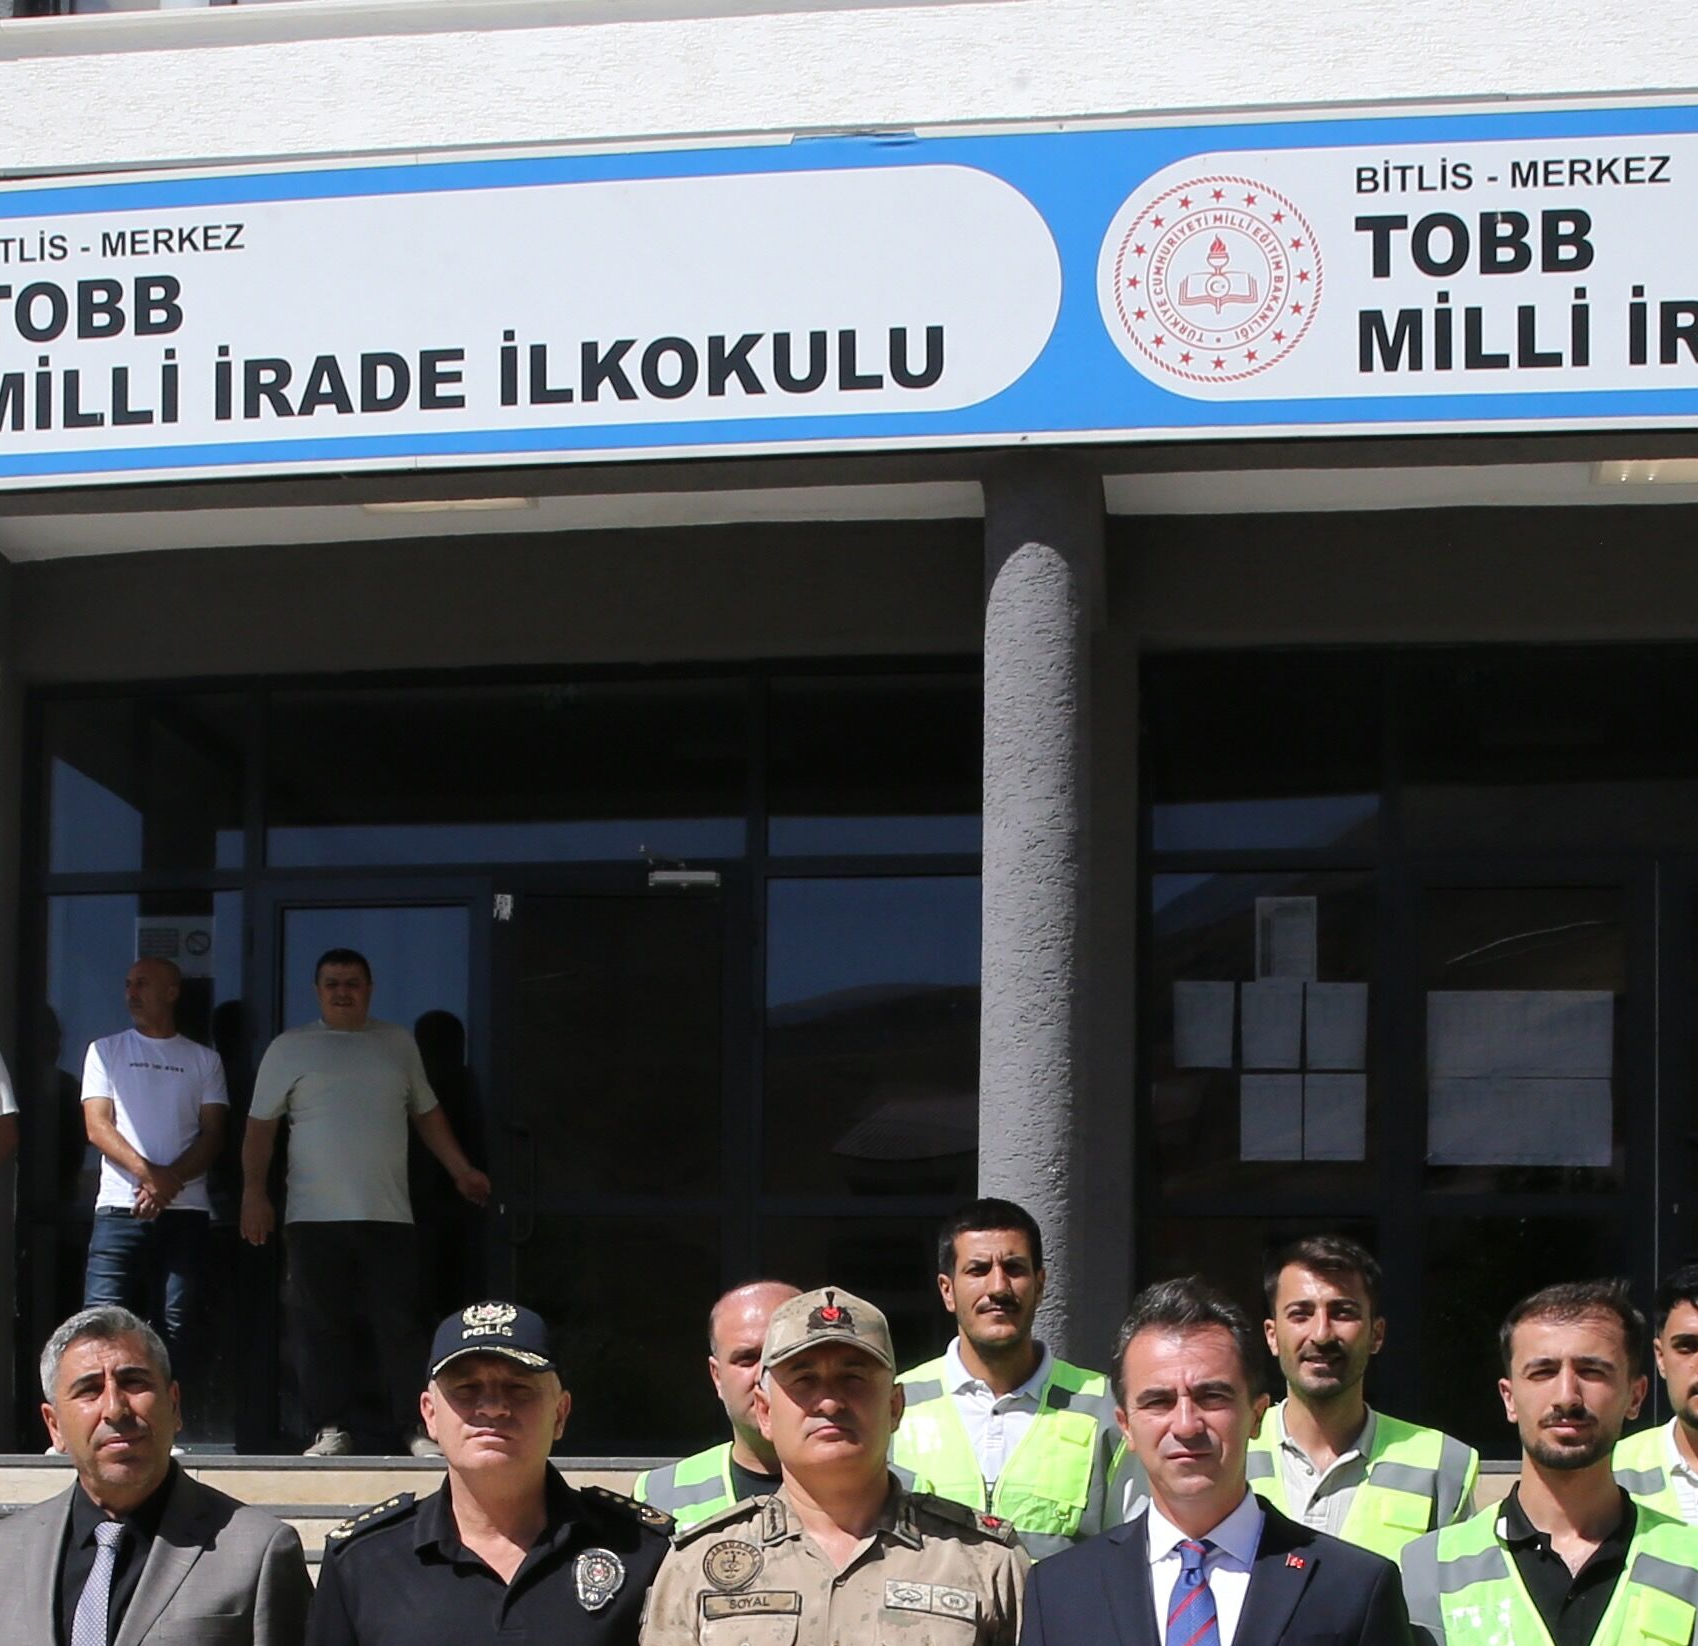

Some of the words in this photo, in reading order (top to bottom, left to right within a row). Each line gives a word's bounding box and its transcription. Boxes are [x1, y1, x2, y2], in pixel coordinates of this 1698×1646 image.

[1356, 158, 1473, 194] BİTLİS
[1511, 155, 1672, 188] MERKEZ
[102, 223, 245, 257] MERKEZ
[1213, 212, 1251, 231] MİLLİ
[1354, 208, 1595, 279] TOBB
[1153, 214, 1209, 295] CUMHURİYETİ
[1157, 299, 1204, 343] TÜRKİYE
[1358, 286, 1590, 373] MİLLİ
[215, 345, 466, 421] İRADE
[500, 325, 944, 407] İLKOKULU
[729, 1596, 770, 1609] SOYAL
